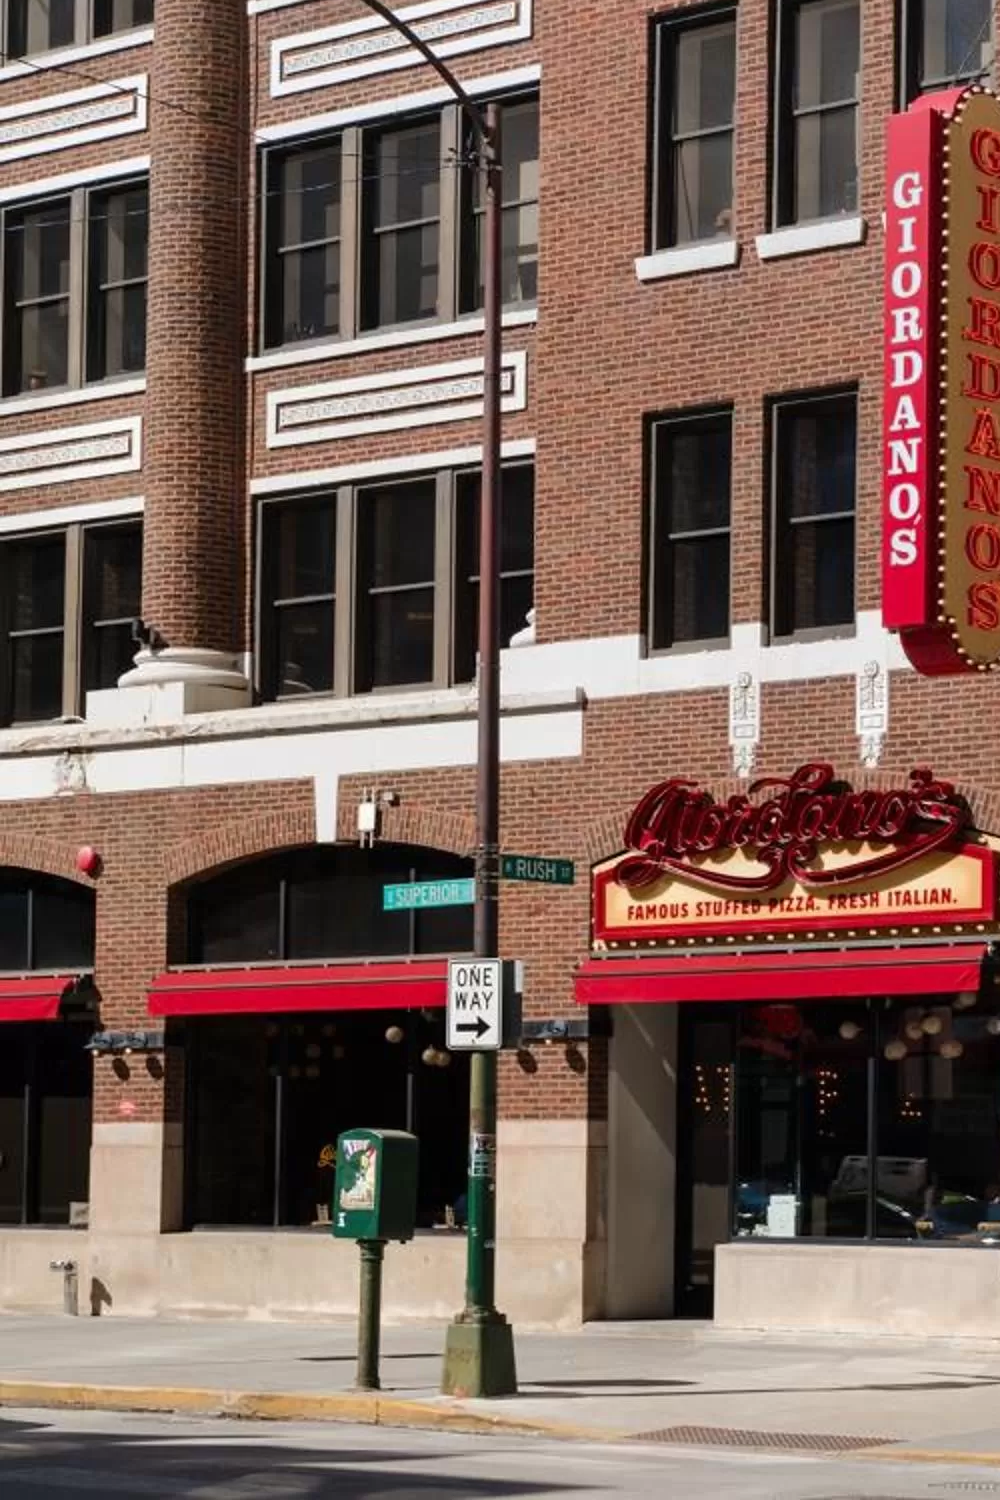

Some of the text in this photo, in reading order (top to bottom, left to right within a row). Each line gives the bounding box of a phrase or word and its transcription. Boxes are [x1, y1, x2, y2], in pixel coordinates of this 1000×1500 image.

[887, 171, 923, 566] GIORDANO'S
[515, 858, 557, 881] RUSH
[396, 883, 459, 906] SUPERIOR
[627, 887, 957, 921] FAMOUS STUFFED PIZZA. FRESH ITALIAN.
[457, 967, 493, 987] ONE
[455, 991, 493, 1011] WAY
